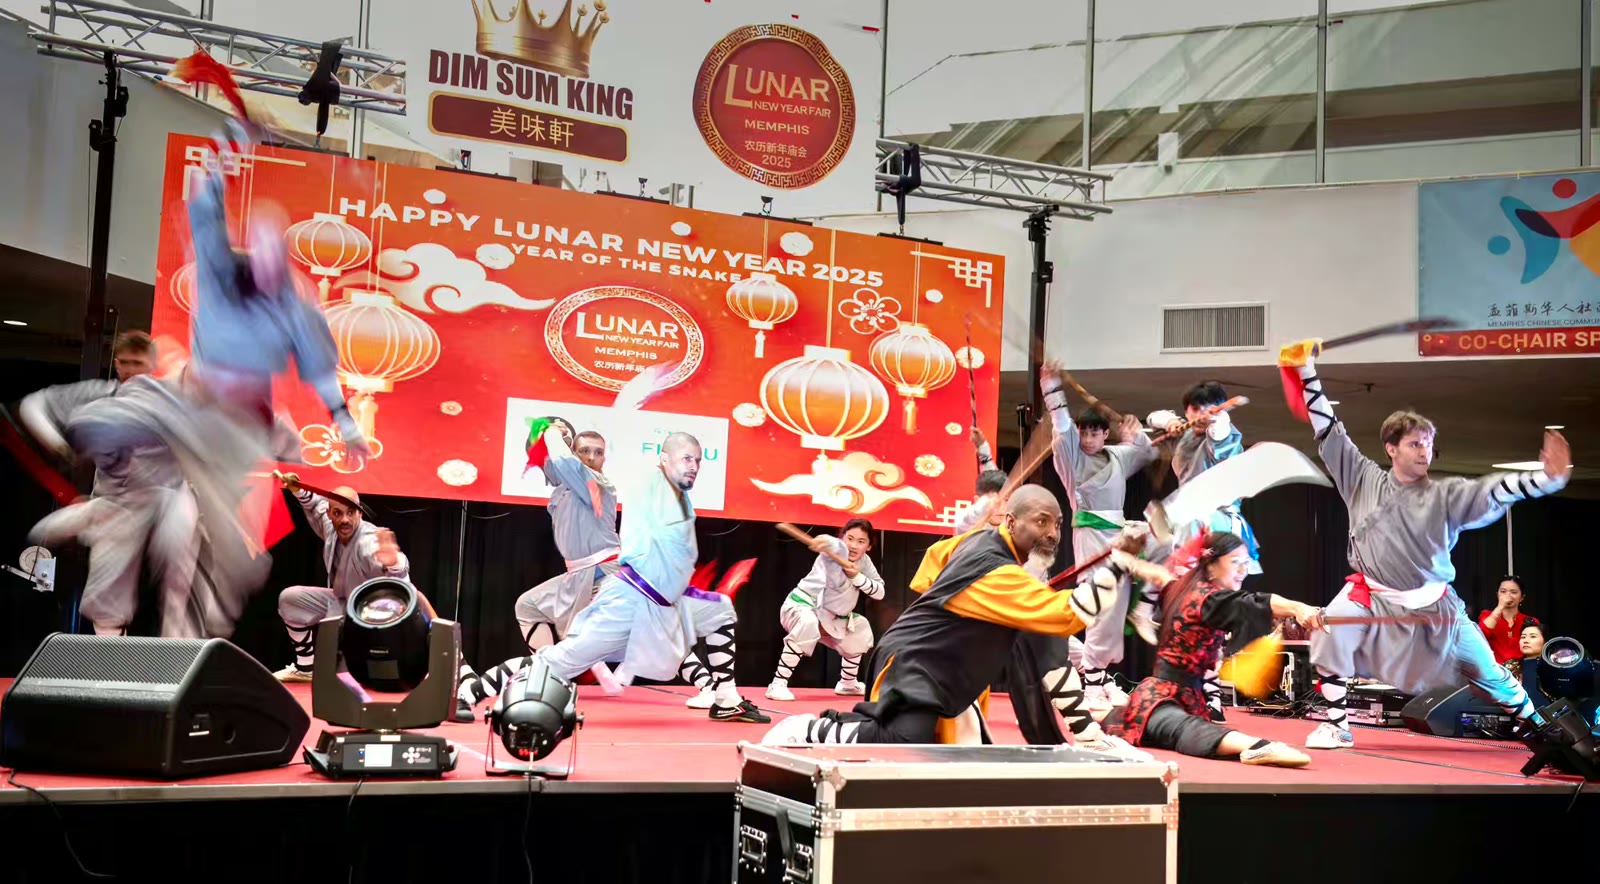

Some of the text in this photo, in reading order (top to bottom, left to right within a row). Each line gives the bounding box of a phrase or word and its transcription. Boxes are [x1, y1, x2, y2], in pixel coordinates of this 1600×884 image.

[429, 49, 634, 121] DIM SUM KING
[724, 64, 830, 109] LUNAR
[753, 100, 831, 118] NEW YEAR FAIR
[490, 106, 574, 148] 美味軒
[744, 119, 810, 135] MEMPHIS
[744, 140, 808, 158] 农历新年庙会
[762, 154, 791, 168] 2025
[339, 197, 883, 287] HAPPY LUNAR NEW YEAR 2025
[511, 243, 742, 283] YEAR OF THE SNAKE
[576, 311, 679, 340] LUNAR
[1487, 320, 1524, 328] MEMPHIS
[1526, 319, 1561, 327] CHINESE
[605, 335, 679, 349] NEW YEAR FAIR
[1458, 331, 1600, 350] CO-CHAIR SP
[594, 346, 658, 360] MEMPHIS
